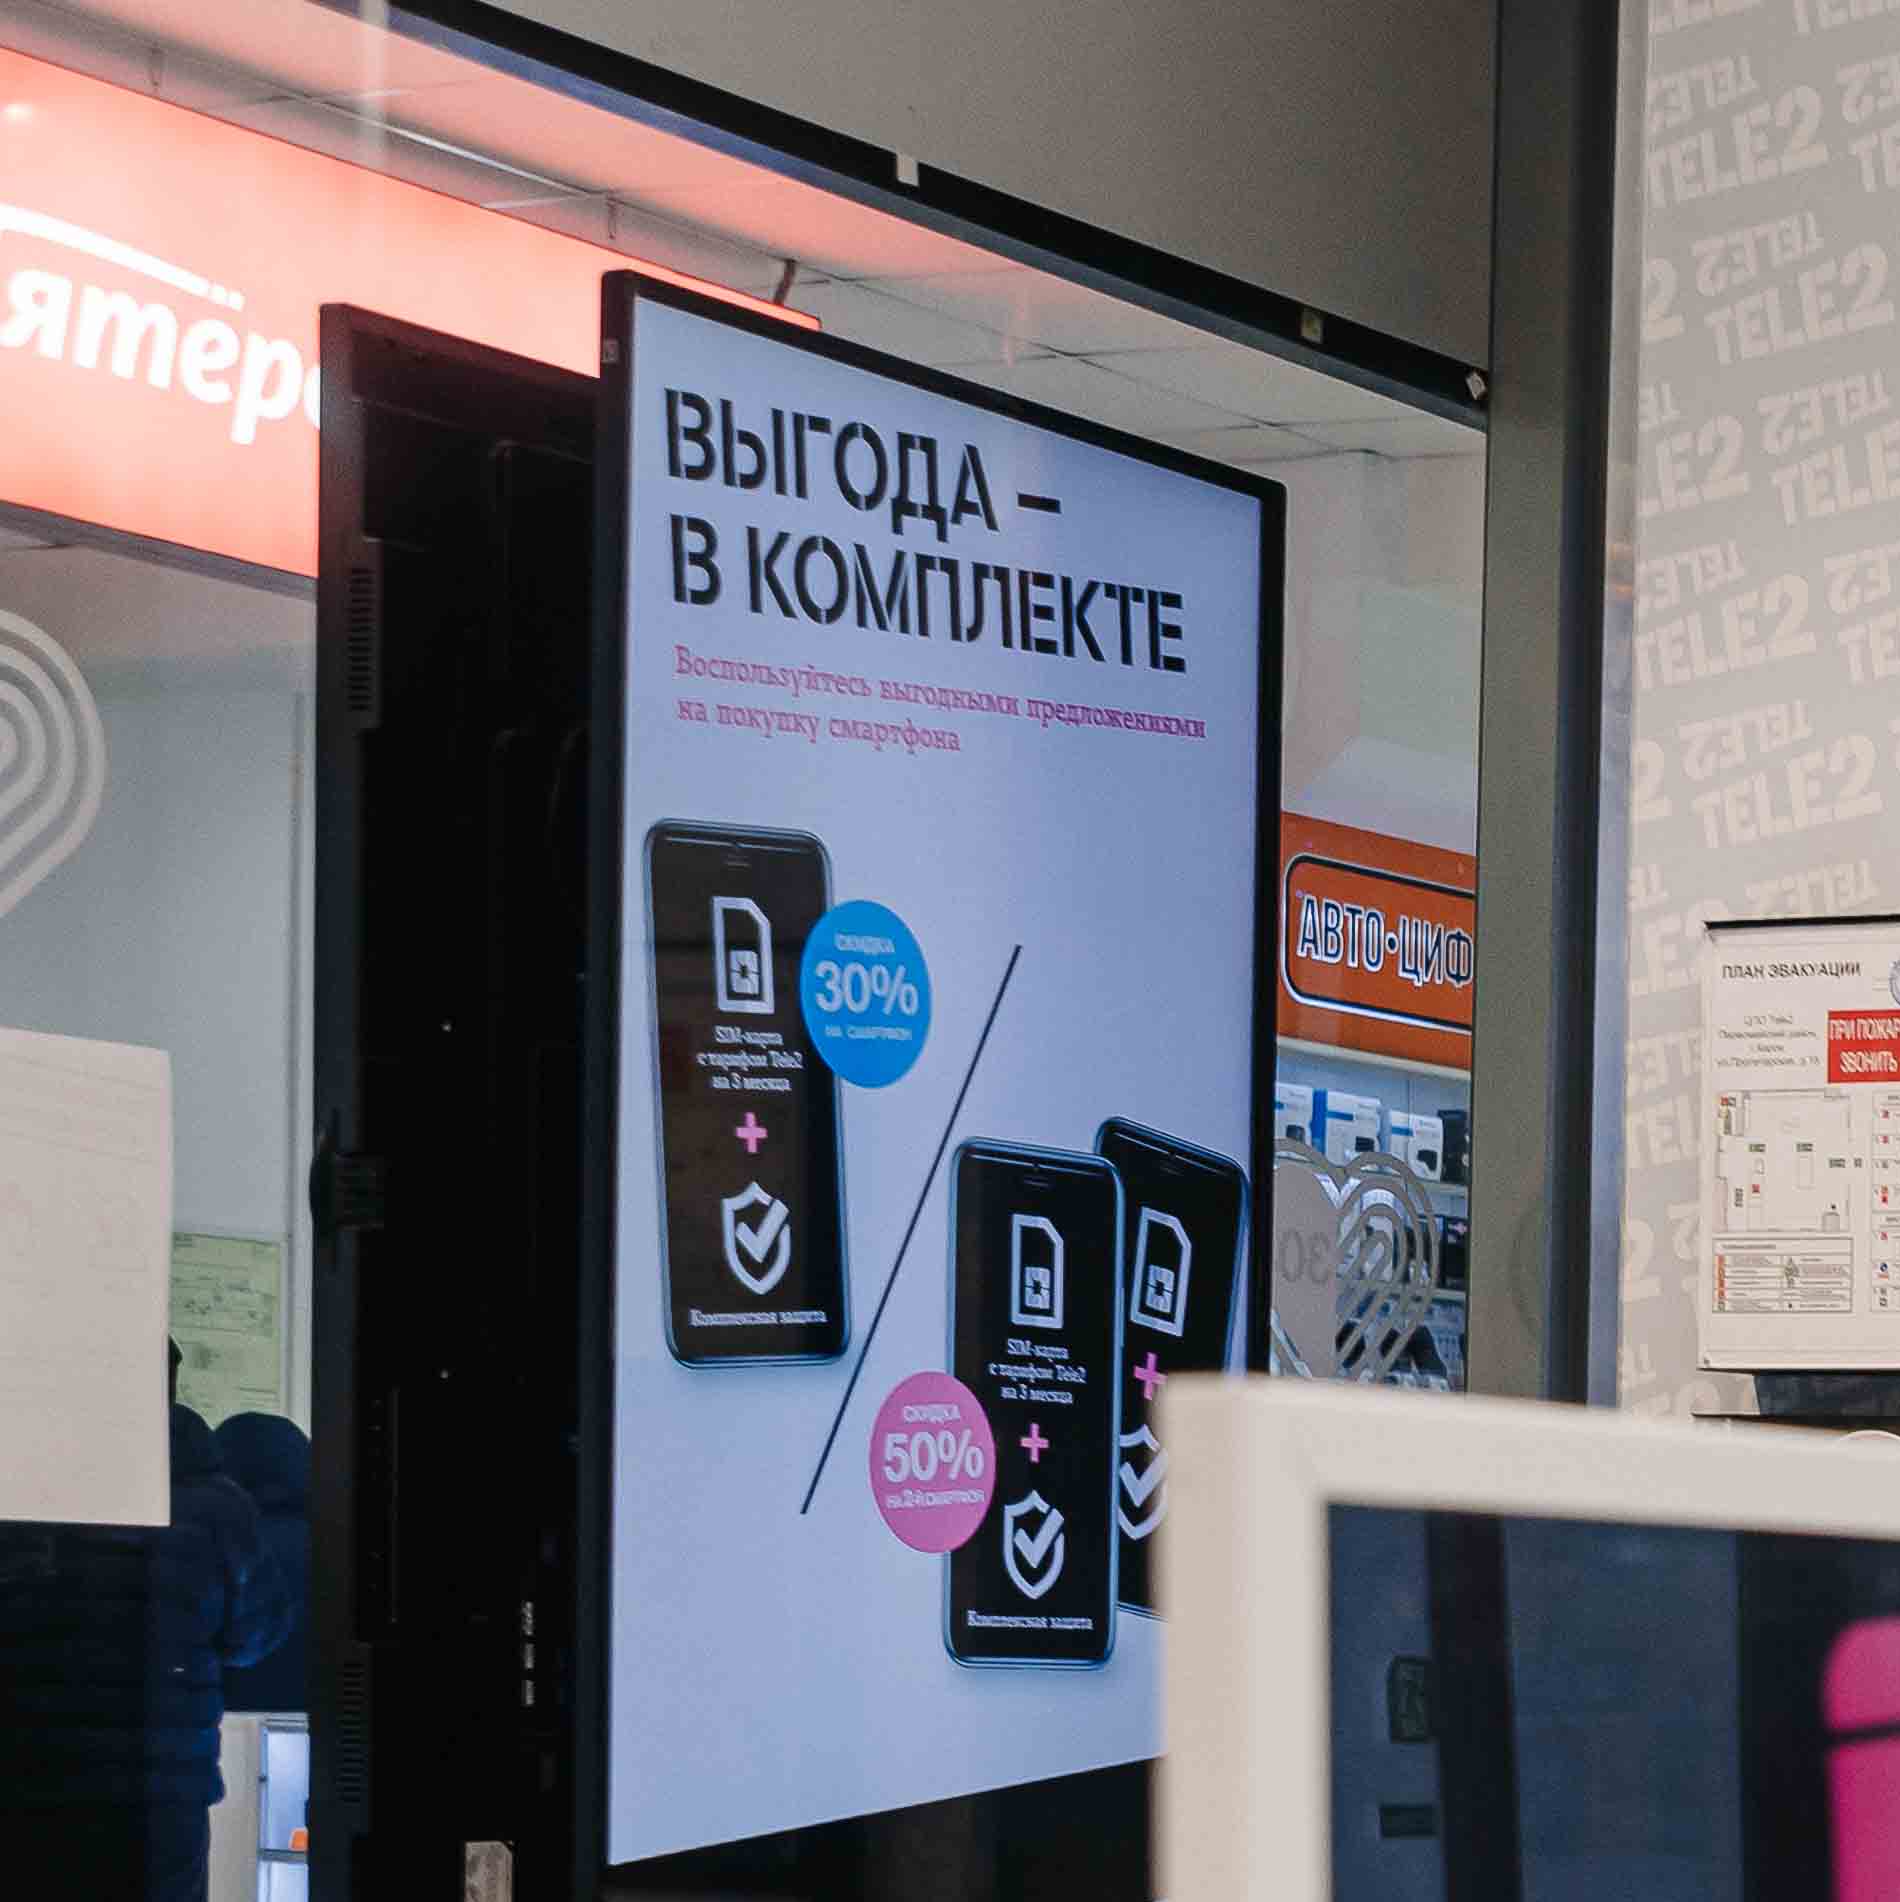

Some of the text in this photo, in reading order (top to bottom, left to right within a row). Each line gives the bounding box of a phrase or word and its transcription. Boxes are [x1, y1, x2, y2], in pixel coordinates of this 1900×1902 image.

[1641, 82, 1827, 207] TELE2
[1706, 241, 1894, 365] TELE2
[664, 387, 999, 543] ВЫГОДА
[669, 513, 1187, 674] В КОМПЛЕКТЕ
[1630, 572, 1816, 691] TELE2
[674, 645, 1206, 742] Воспользуйтесь выгодными предложениями
[678, 698, 961, 755] на покупку смартфона
[1695, 732, 1883, 850] TELE2
[816, 960, 919, 1017] 30%
[1721, 962, 1862, 980] ПЛАН ЭВАКУАЦИИ
[1829, 1019, 1855, 1041] ПРИ
[1840, 1050, 1899, 1073] ЗВОНИТЬ
[884, 1427, 985, 1484] 50%
